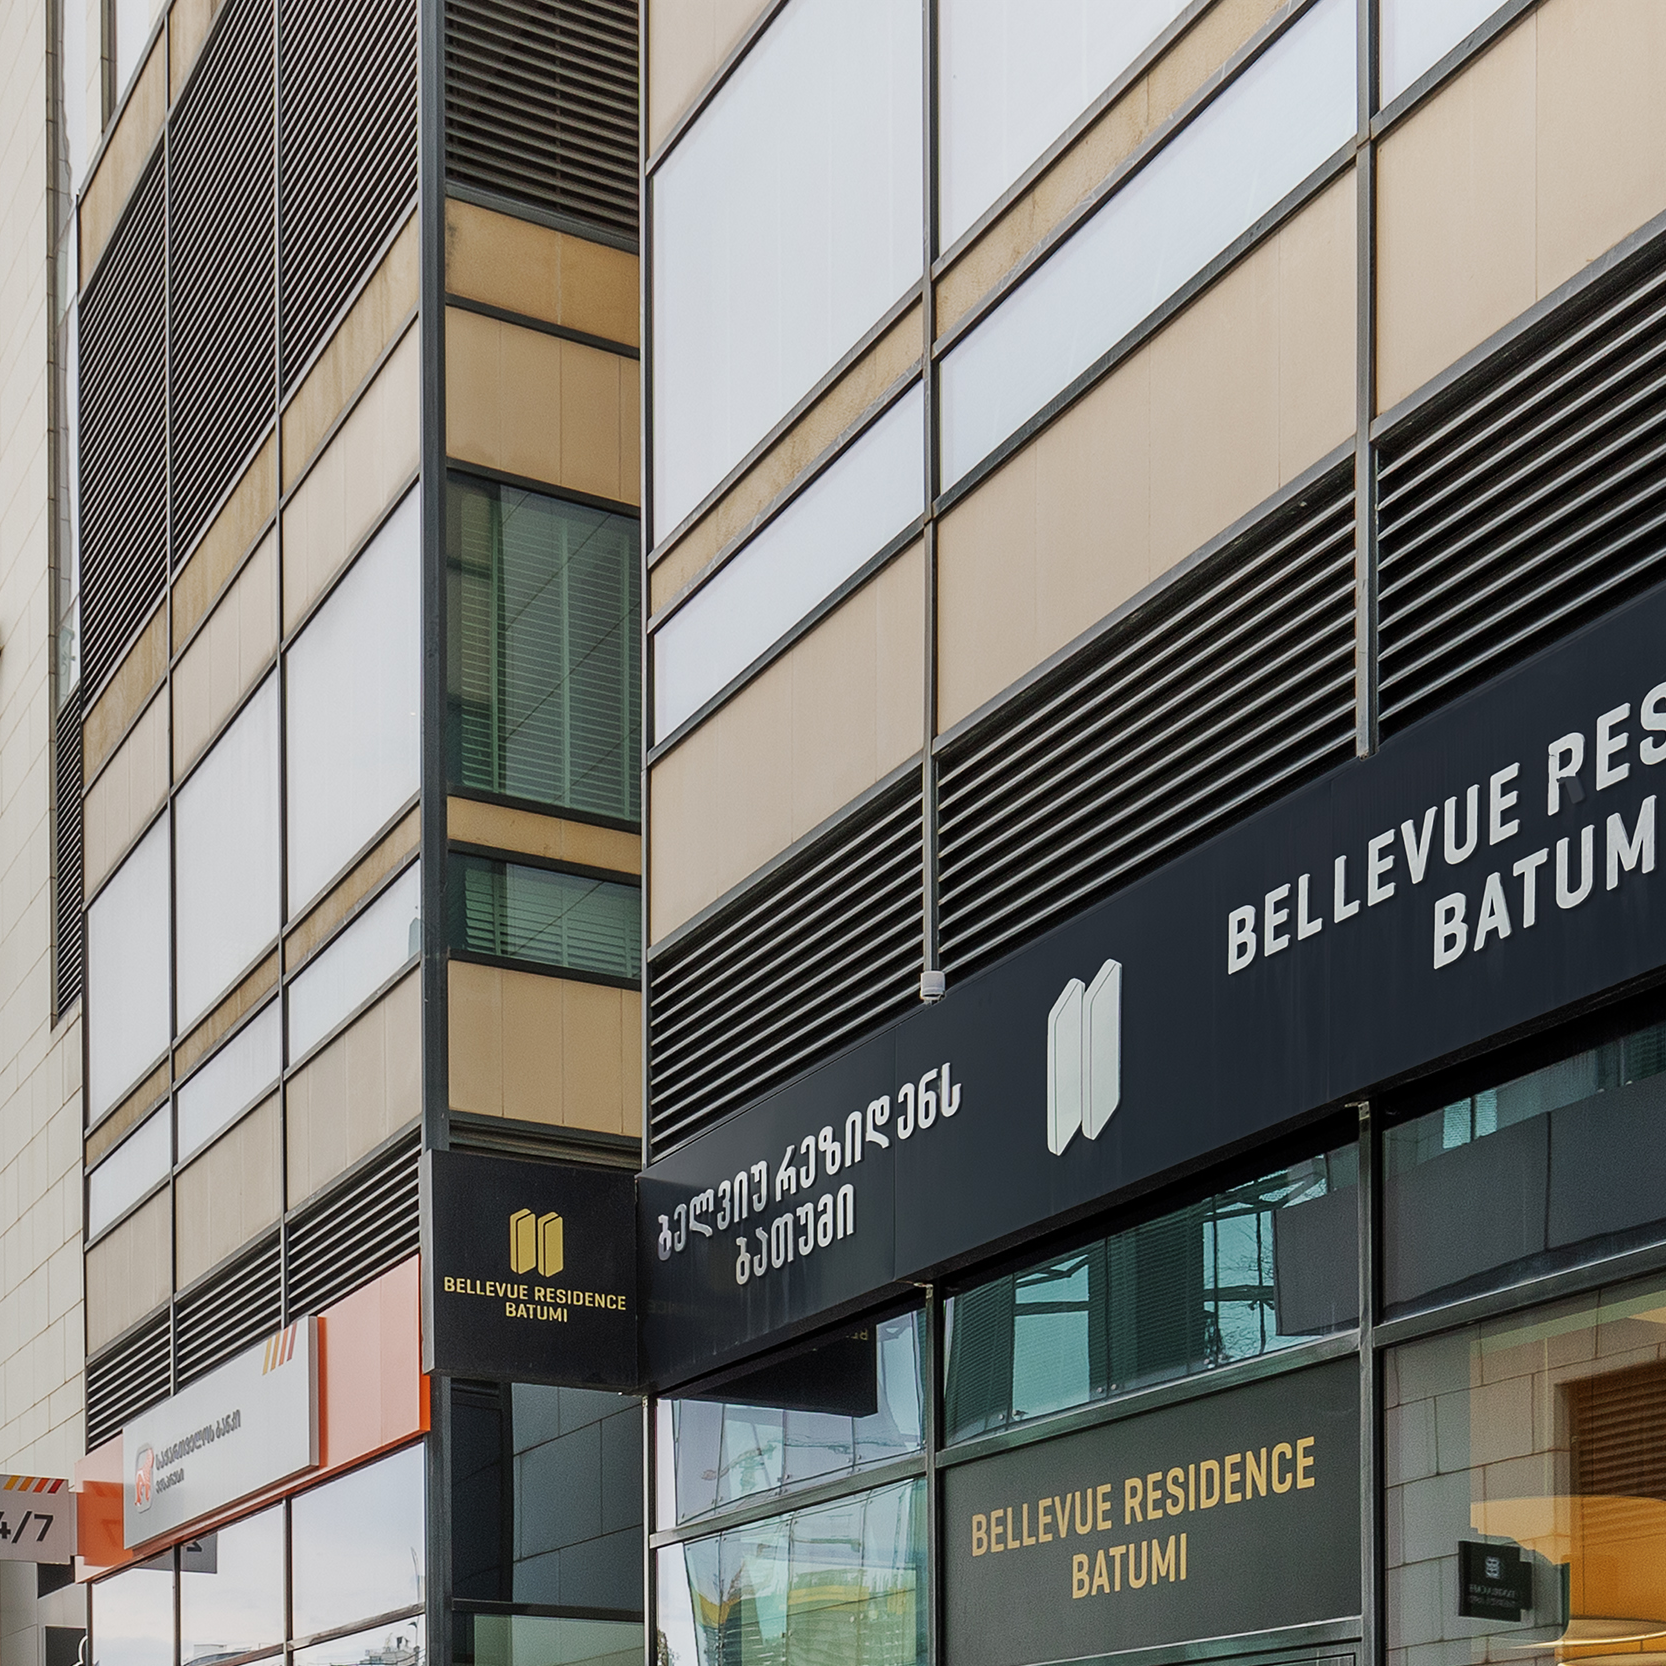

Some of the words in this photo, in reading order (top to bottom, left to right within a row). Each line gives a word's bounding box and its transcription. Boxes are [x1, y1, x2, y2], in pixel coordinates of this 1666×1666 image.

[1227, 762, 1521, 975] BELLEVUE
[657, 1160, 768, 1260] ბელვიუ
[775, 1062, 962, 1202] რეზიდენს
[735, 1183, 854, 1285] ბათუმი
[444, 1276, 529, 1300] BELLEVUE
[534, 1286, 627, 1311] RESIDENCE
[505, 1302, 568, 1323] BATUMI
[971, 1483, 1113, 1558] BELLEVUE
[1124, 1435, 1315, 1526] RESIDENCE
[1071, 1532, 1187, 1600] BATUMI
